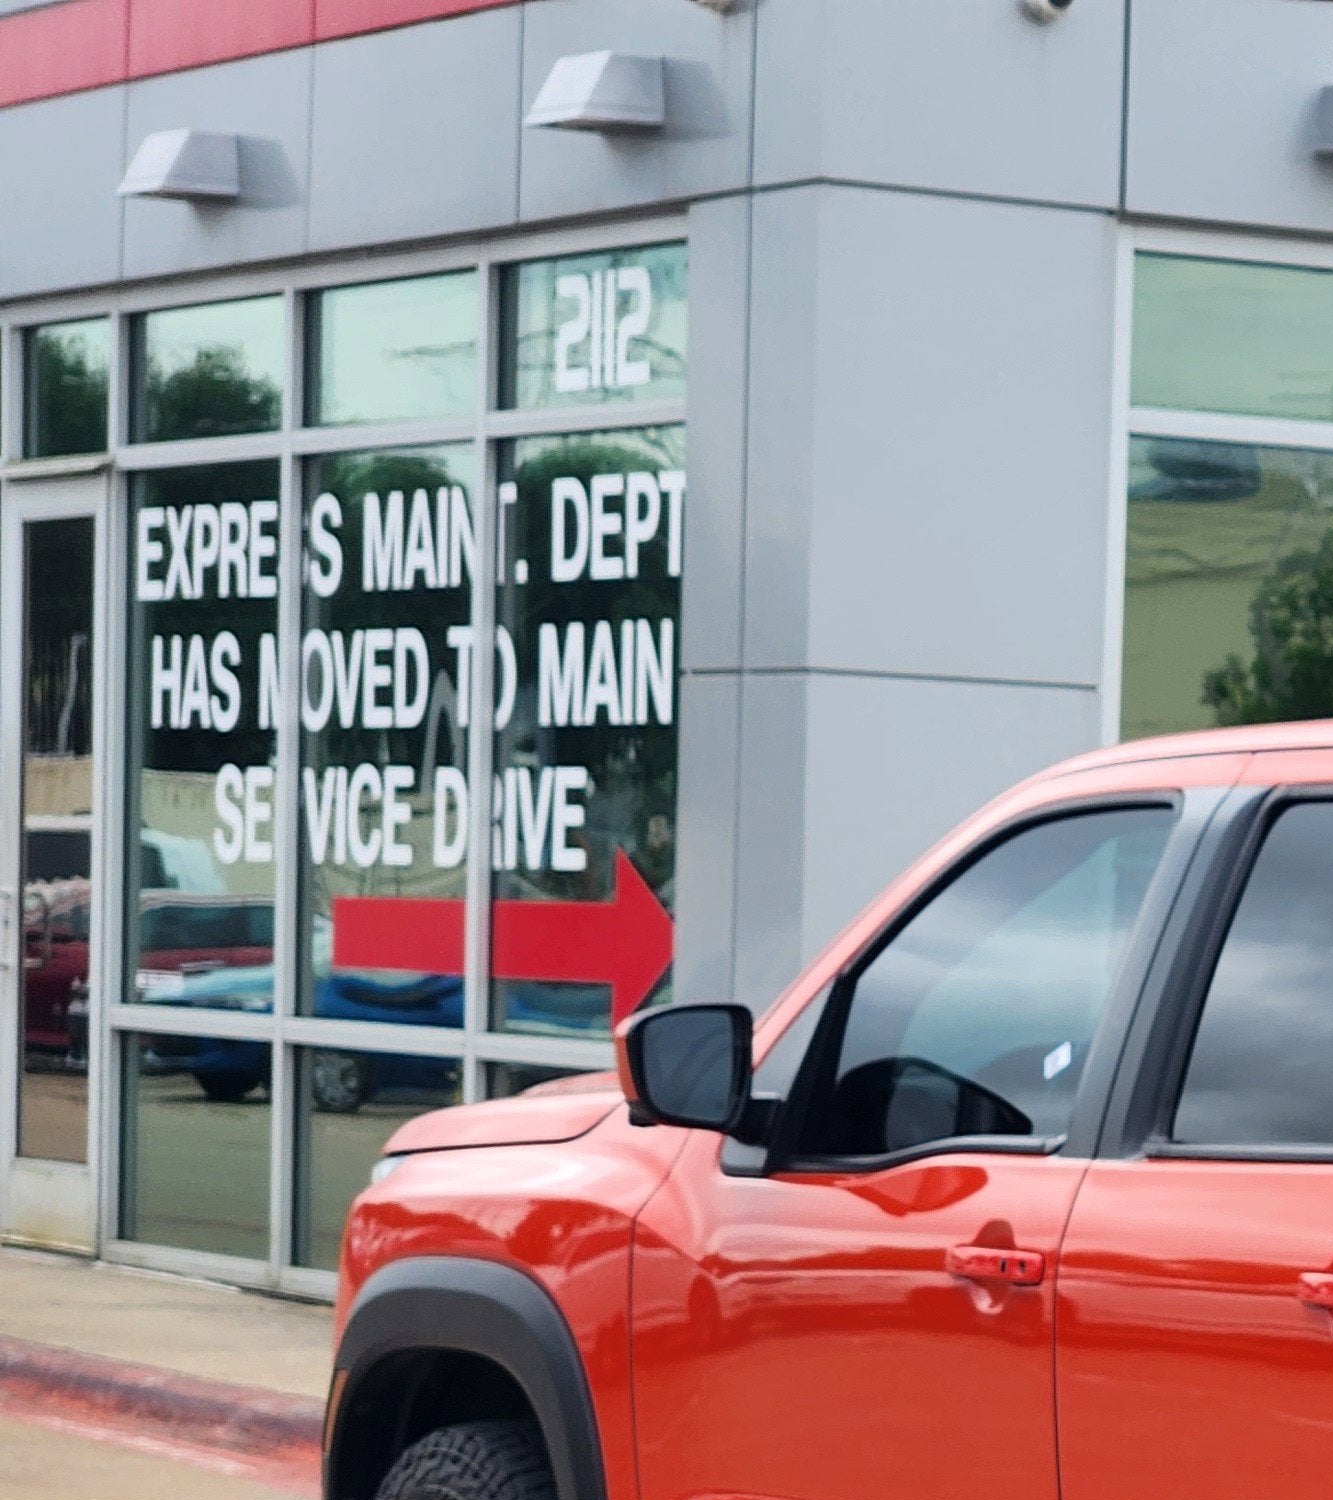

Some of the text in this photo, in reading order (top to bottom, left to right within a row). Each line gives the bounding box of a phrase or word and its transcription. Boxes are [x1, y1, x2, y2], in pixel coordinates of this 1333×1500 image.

[555, 266, 651, 392] 2112
[137, 492, 344, 600] EXPRES
[151, 630, 241, 732] HAS
[538, 617, 674, 727] MAIN
[213, 762, 415, 867] SEVICE
